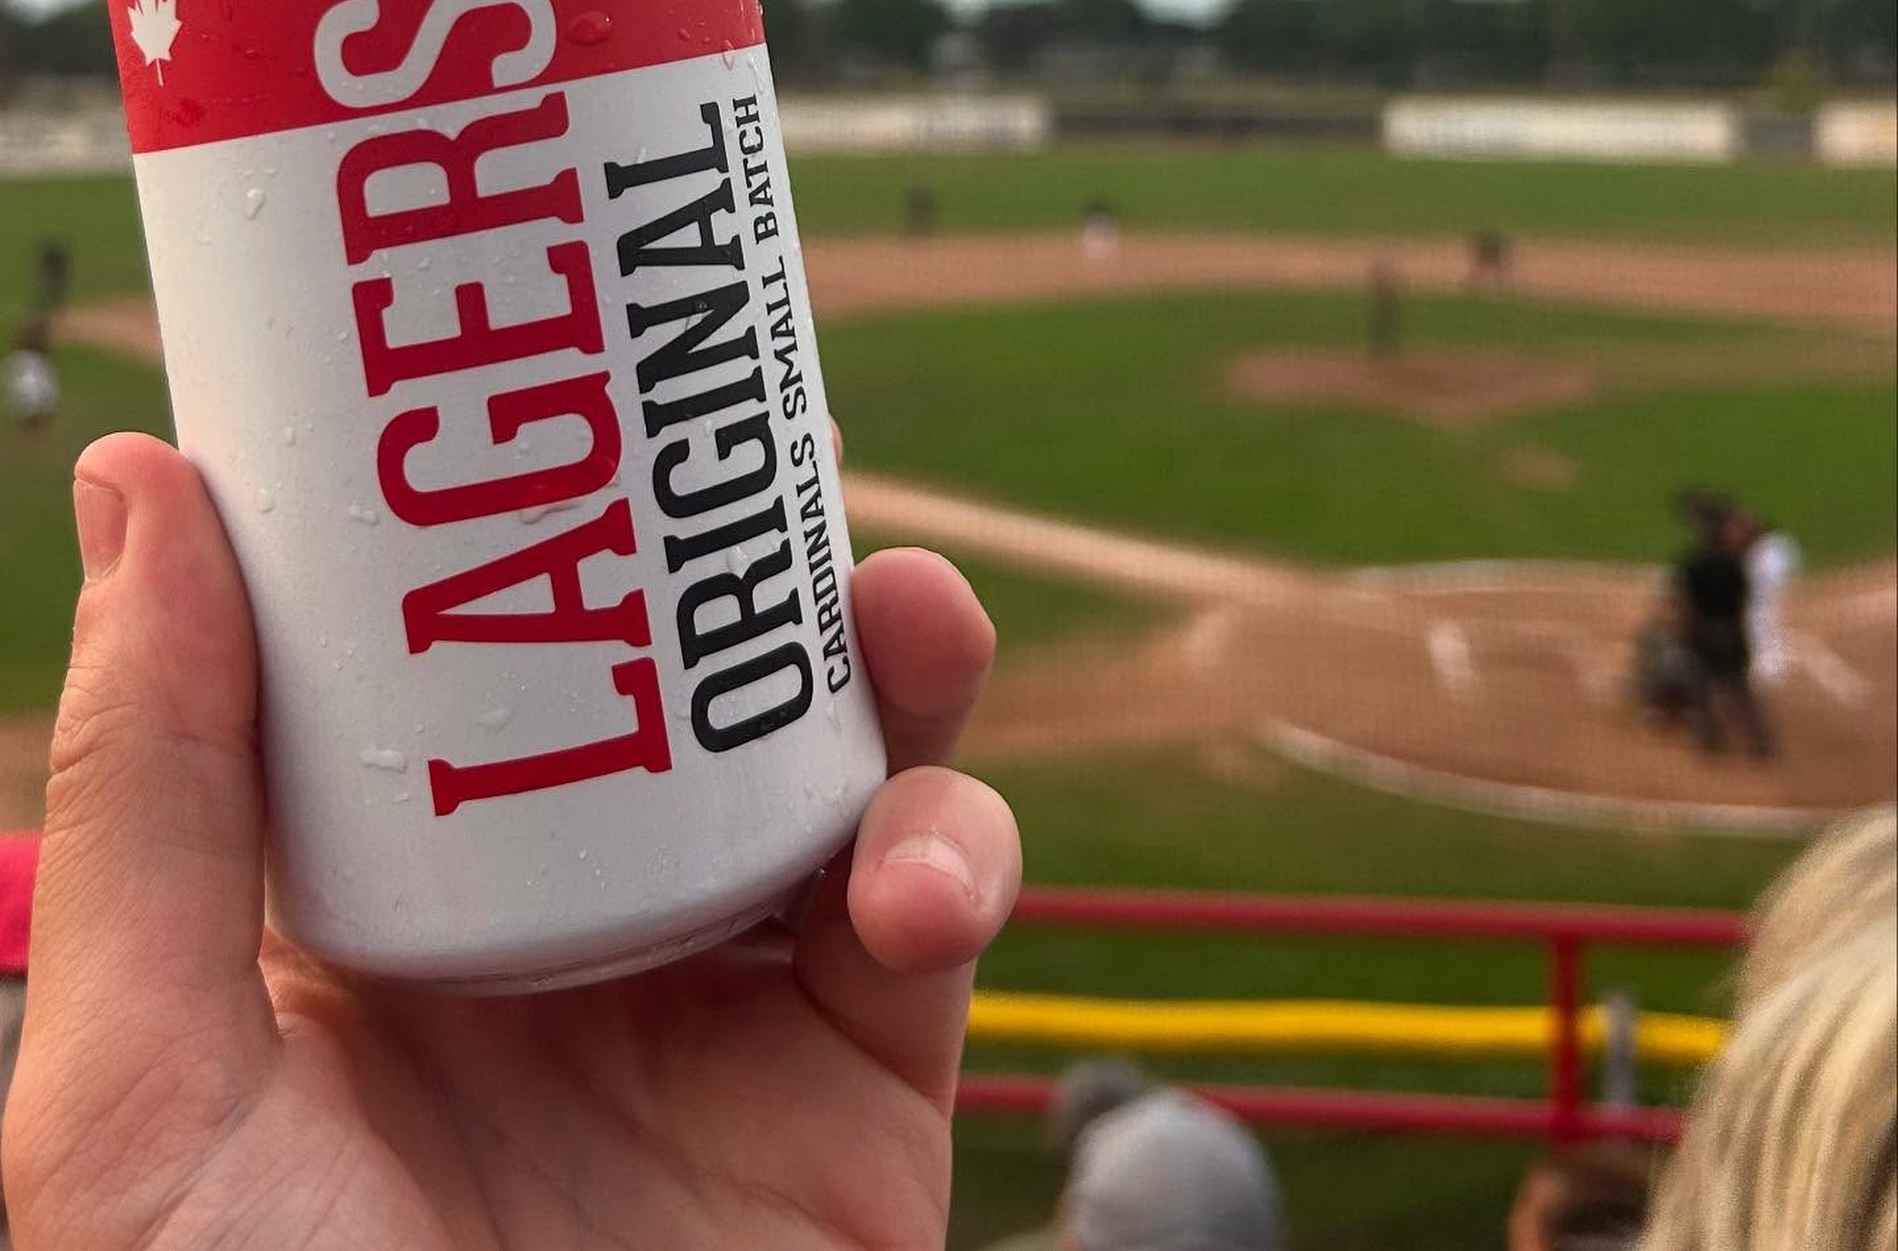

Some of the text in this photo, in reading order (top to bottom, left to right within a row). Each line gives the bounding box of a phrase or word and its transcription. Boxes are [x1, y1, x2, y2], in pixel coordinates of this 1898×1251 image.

[604, 101, 813, 753] ORIGINAL
[732, 93, 850, 694] CARDINALS SMALL BATCH
